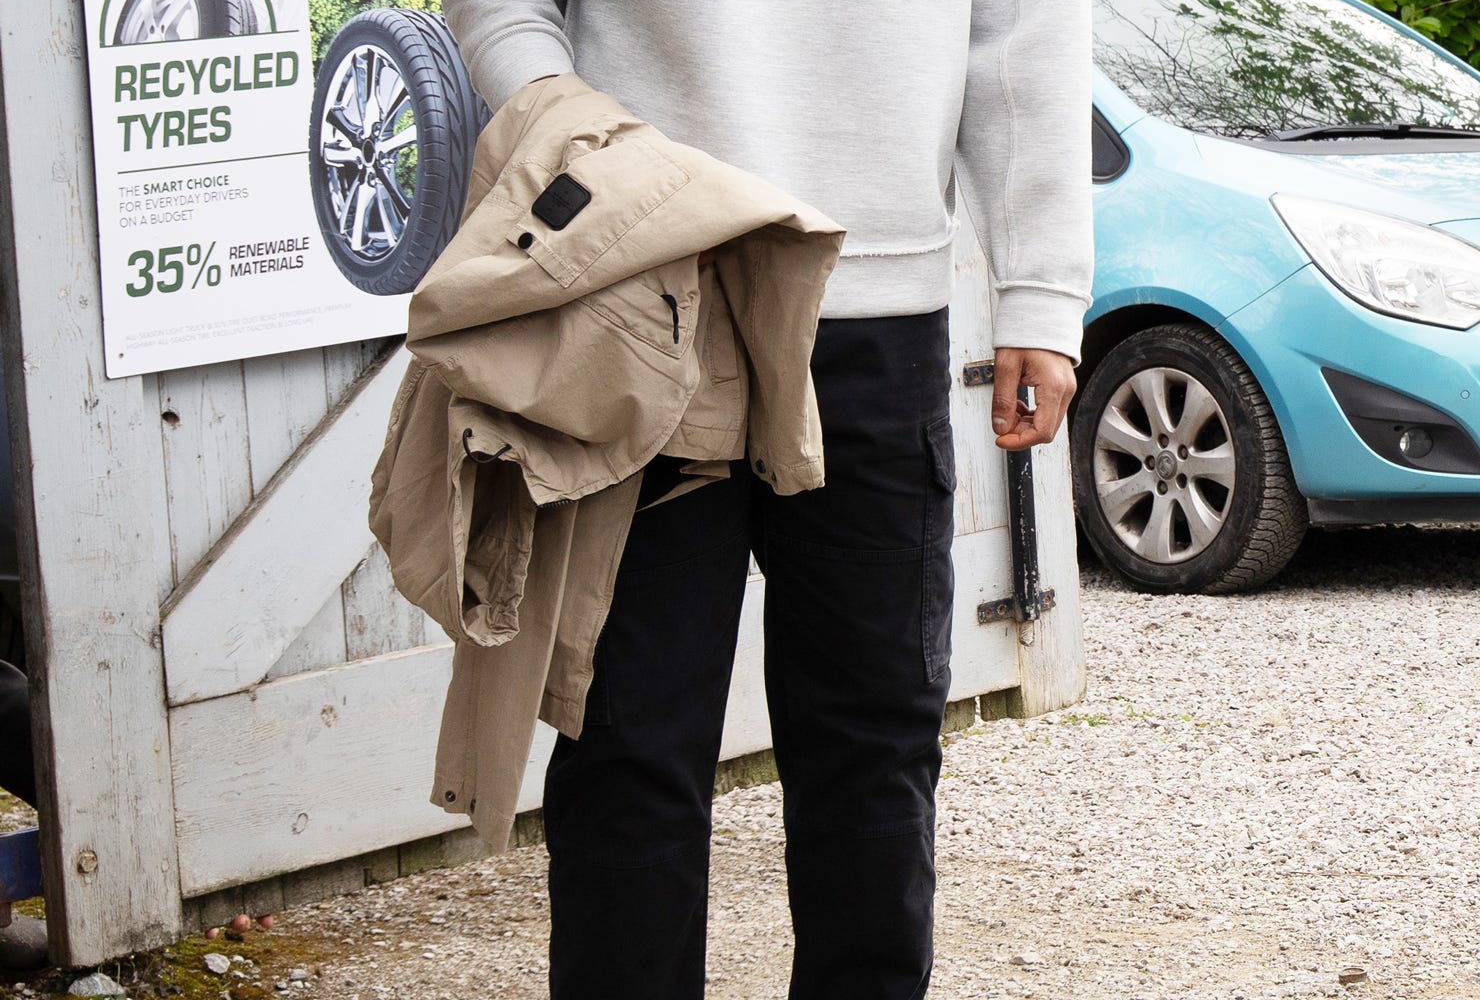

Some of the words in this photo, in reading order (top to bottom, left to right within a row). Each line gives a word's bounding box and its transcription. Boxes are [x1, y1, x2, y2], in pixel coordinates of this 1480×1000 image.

[115, 50, 299, 103] RECYCLED
[117, 105, 232, 152] TYRES
[118, 185, 140, 198] THE
[143, 180, 184, 195] SMART
[186, 175, 230, 190] CHOICE
[119, 200, 142, 213] FOR
[145, 193, 201, 210] EVERYDAY
[203, 187, 250, 203] DRIVERS
[119, 216, 137, 229] ON
[140, 215, 148, 226] A
[150, 208, 195, 225] BUDGET
[229, 236, 310, 260] RENEWABLE
[125, 240, 222, 298] 35%
[229, 254, 304, 278] MATERIALS
